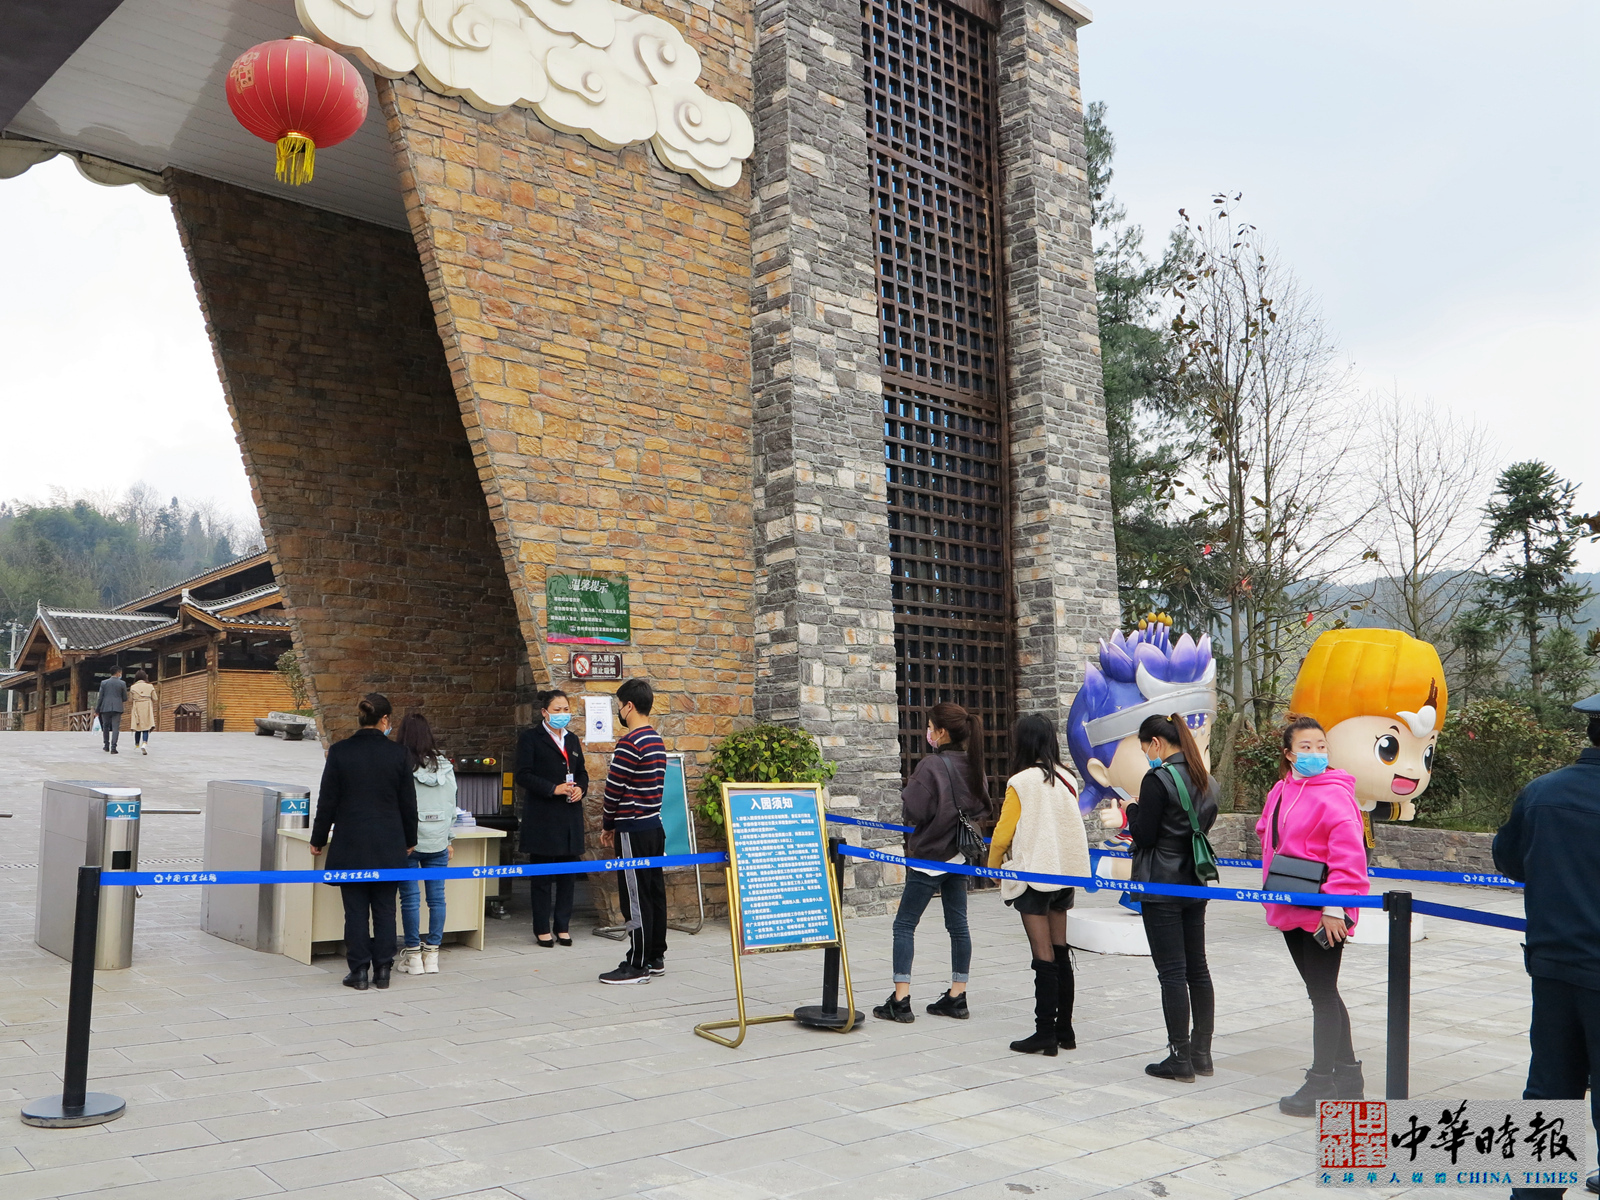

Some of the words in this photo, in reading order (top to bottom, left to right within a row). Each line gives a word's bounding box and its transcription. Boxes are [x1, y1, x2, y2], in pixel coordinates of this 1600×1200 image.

[568, 578, 609, 594] 温馨提示
[591, 654, 616, 662] 进入景区
[591, 666, 616, 675] 禁止吸烟
[114, 804, 136, 813] 入口
[287, 801, 306, 810] 入口
[750, 797, 793, 811] 入园须知
